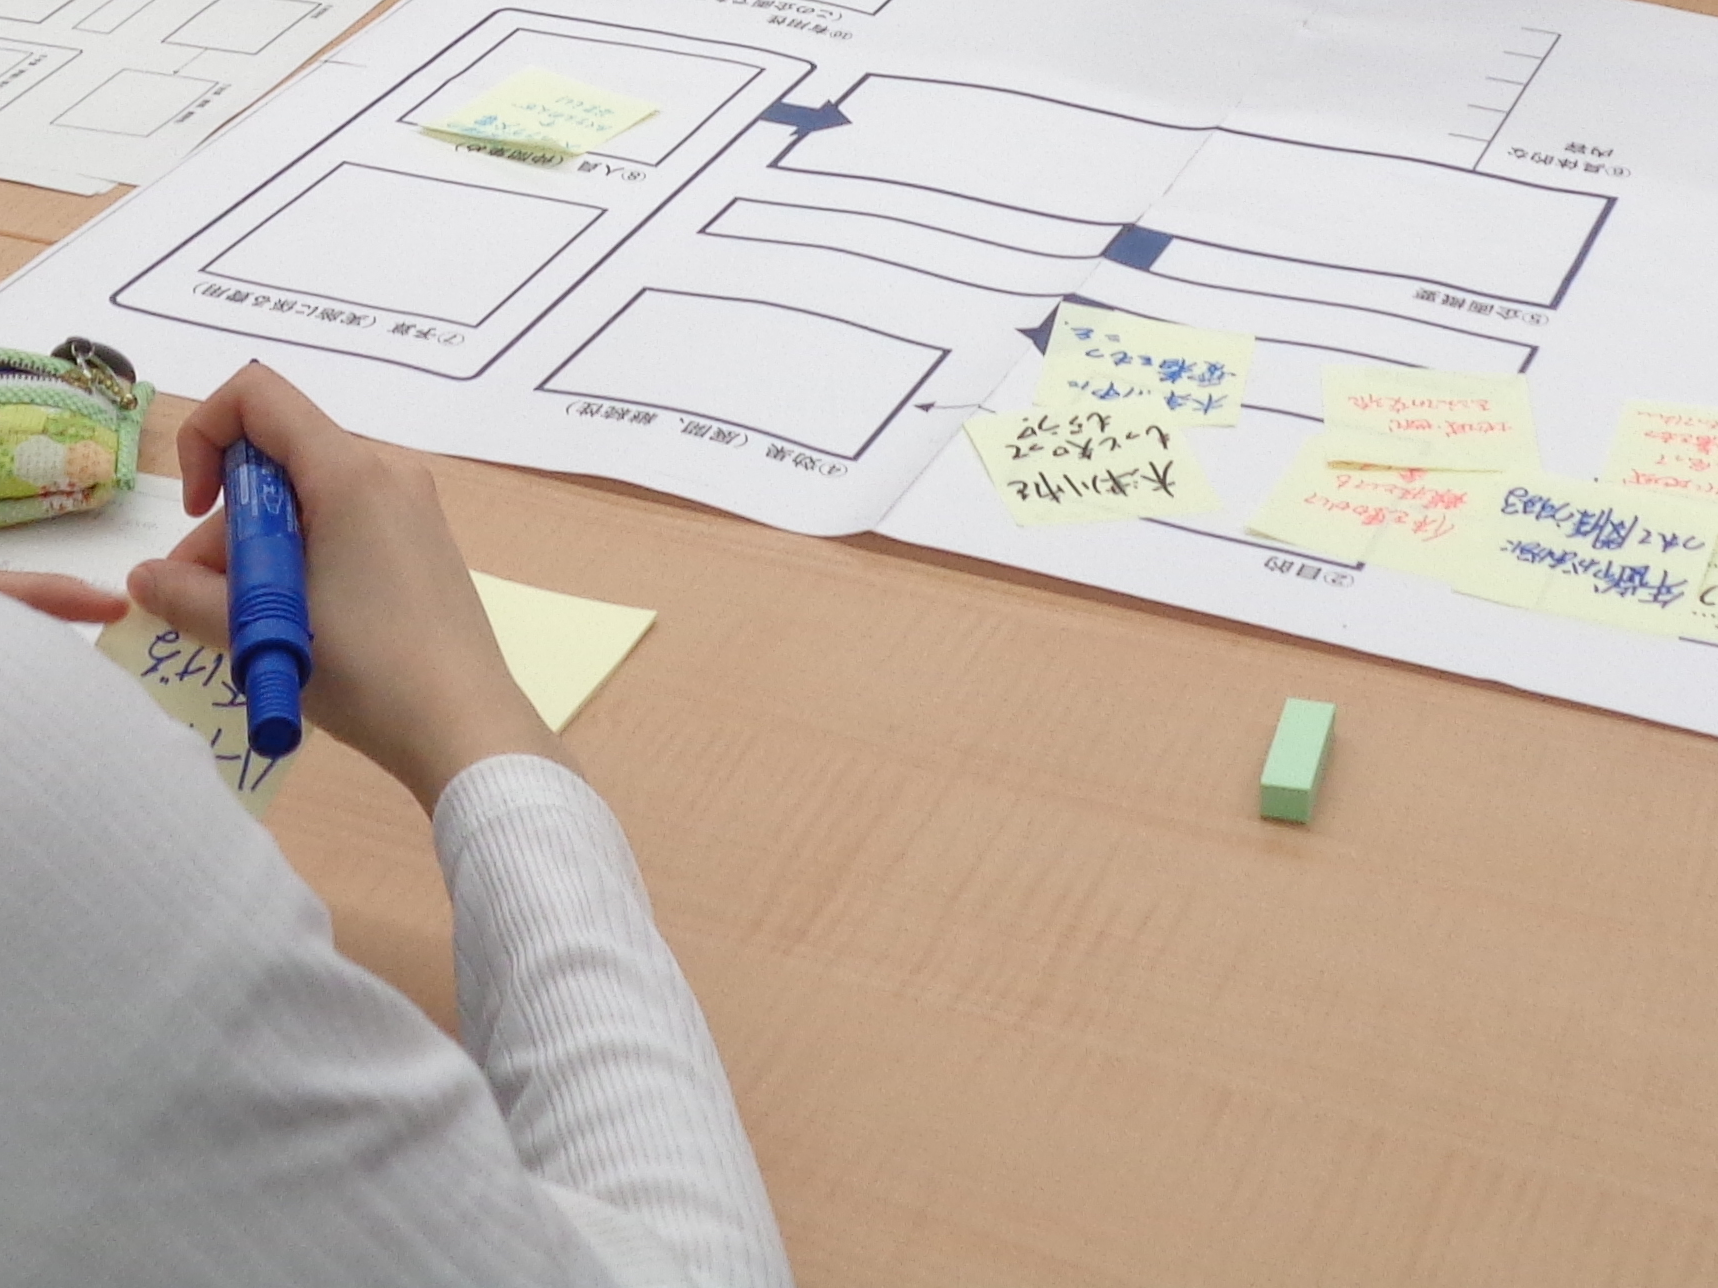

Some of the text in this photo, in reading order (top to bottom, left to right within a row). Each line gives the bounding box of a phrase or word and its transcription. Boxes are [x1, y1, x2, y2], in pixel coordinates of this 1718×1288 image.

[1412, 287, 1549, 326] ⑤企画概要
[1006, 426, 1169, 460] もっと知って
[1008, 461, 1175, 504] 木津川市を
[1265, 556, 1354, 589] ②目的
